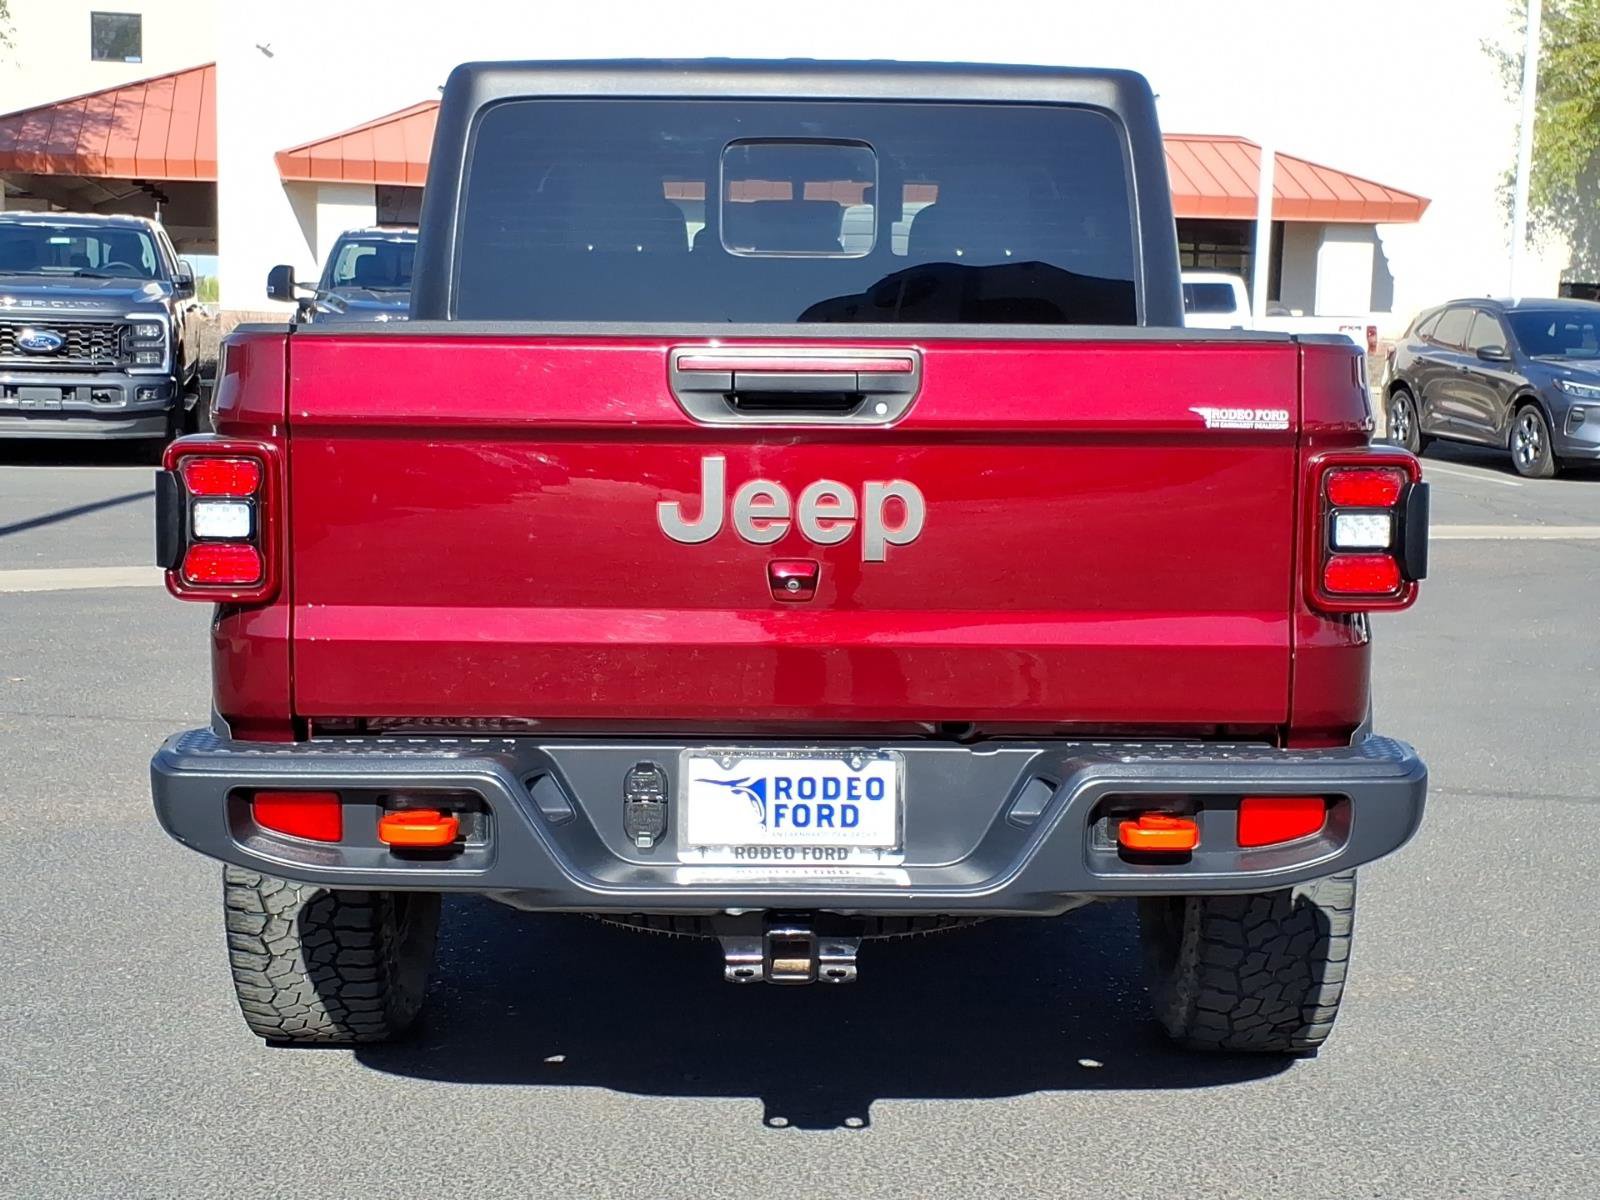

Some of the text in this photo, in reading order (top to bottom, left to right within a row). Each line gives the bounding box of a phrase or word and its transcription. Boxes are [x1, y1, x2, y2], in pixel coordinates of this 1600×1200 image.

[1211, 409, 1289, 421] RODEO FORD
[657, 455, 926, 562] Jeep
[774, 776, 885, 800] RODEO
[774, 804, 859, 828] FORD
[735, 846, 848, 860] RODEO FORD
